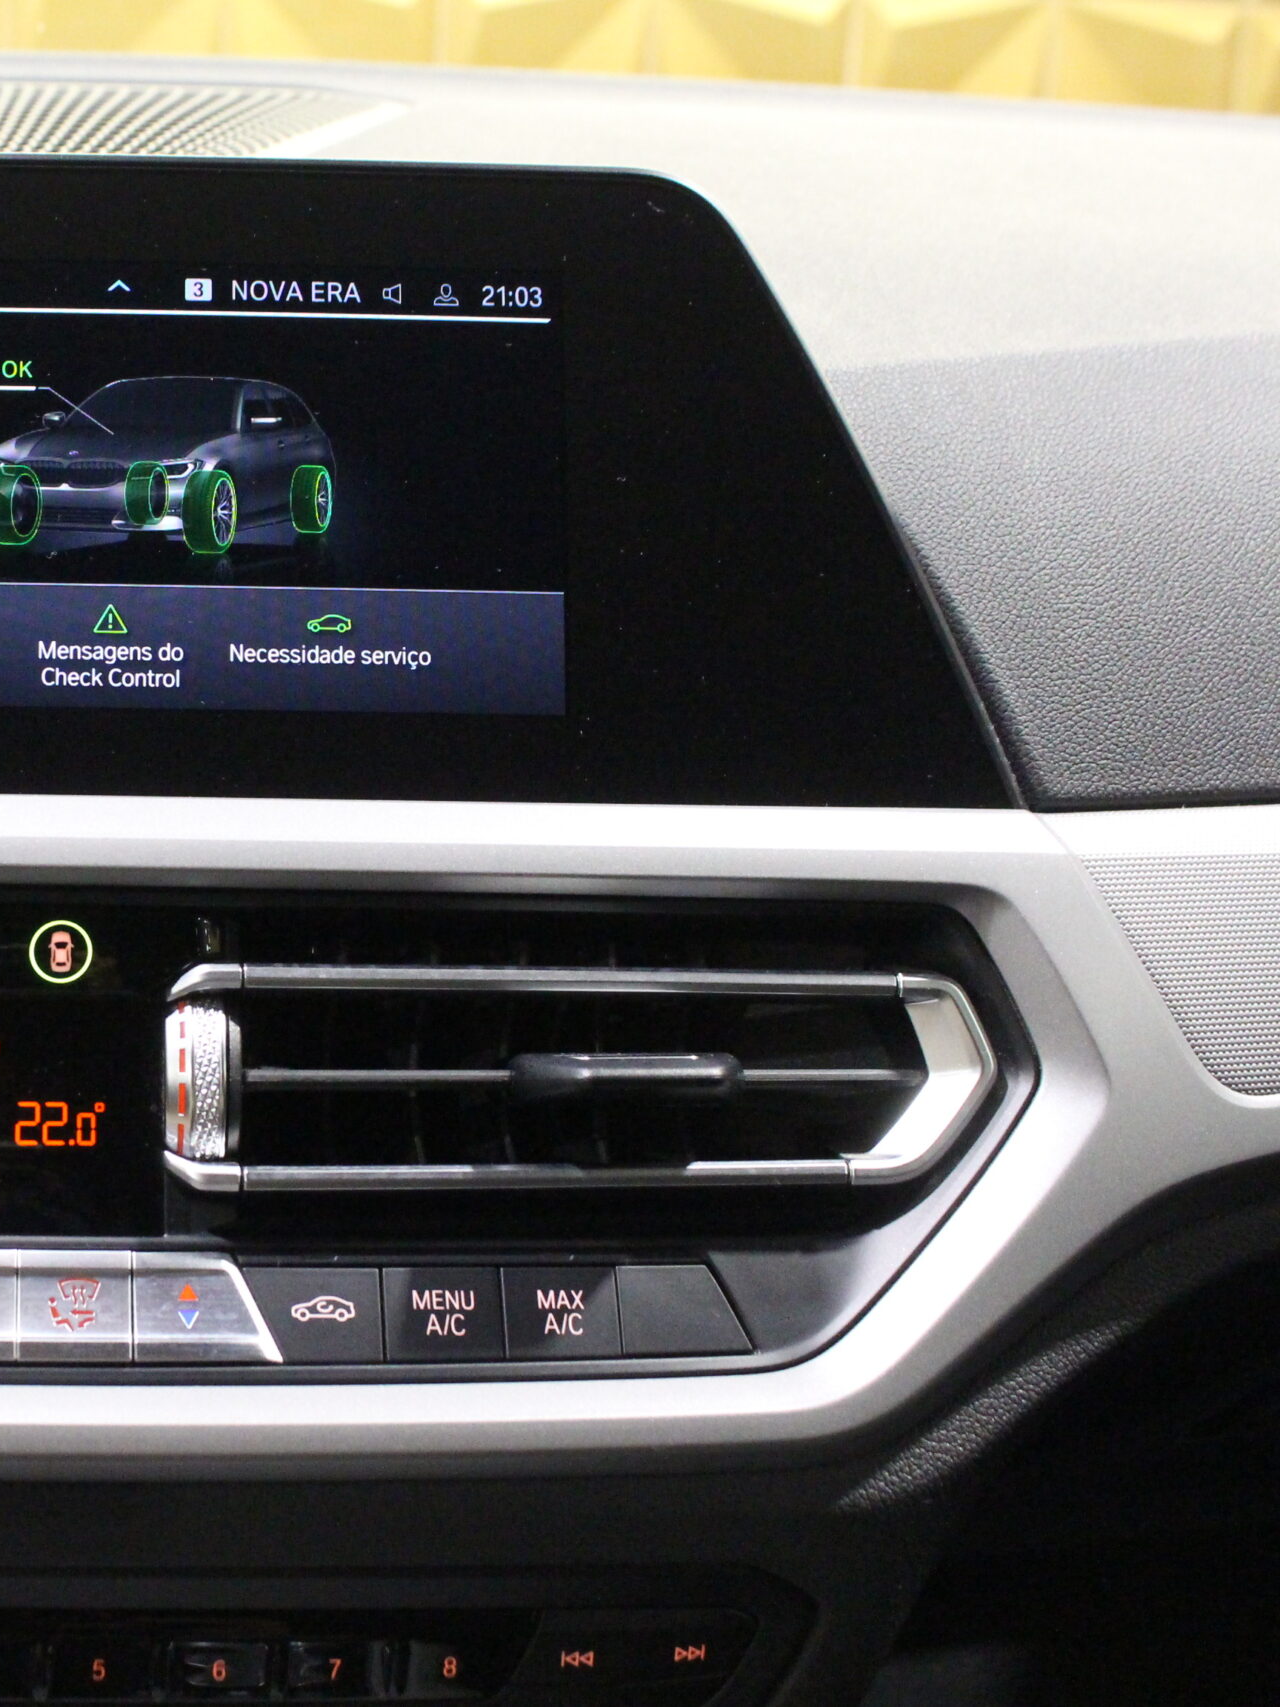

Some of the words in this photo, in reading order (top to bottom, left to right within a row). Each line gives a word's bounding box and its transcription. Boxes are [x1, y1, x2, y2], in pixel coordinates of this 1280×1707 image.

[193, 281, 204, 299] 3
[231, 280, 303, 302] NOVA
[311, 281, 361, 303] ERA
[481, 286, 543, 308] 21:03
[2, 360, 33, 379] OK
[37, 640, 152, 666] Mensagens
[158, 642, 184, 663] do
[229, 644, 355, 666] Necessidade
[361, 646, 432, 670] serviço
[41, 667, 102, 688] Check
[108, 668, 180, 689] Control
[412, 1290, 474, 1312] MENU
[536, 1289, 584, 1311] MAX
[426, 1313, 466, 1337] A/C
[545, 1313, 584, 1337] A/C
[92, 1658, 106, 1681] 5
[211, 1660, 226, 1682] 6
[329, 1659, 342, 1681] 7
[443, 1656, 456, 1678] 8
